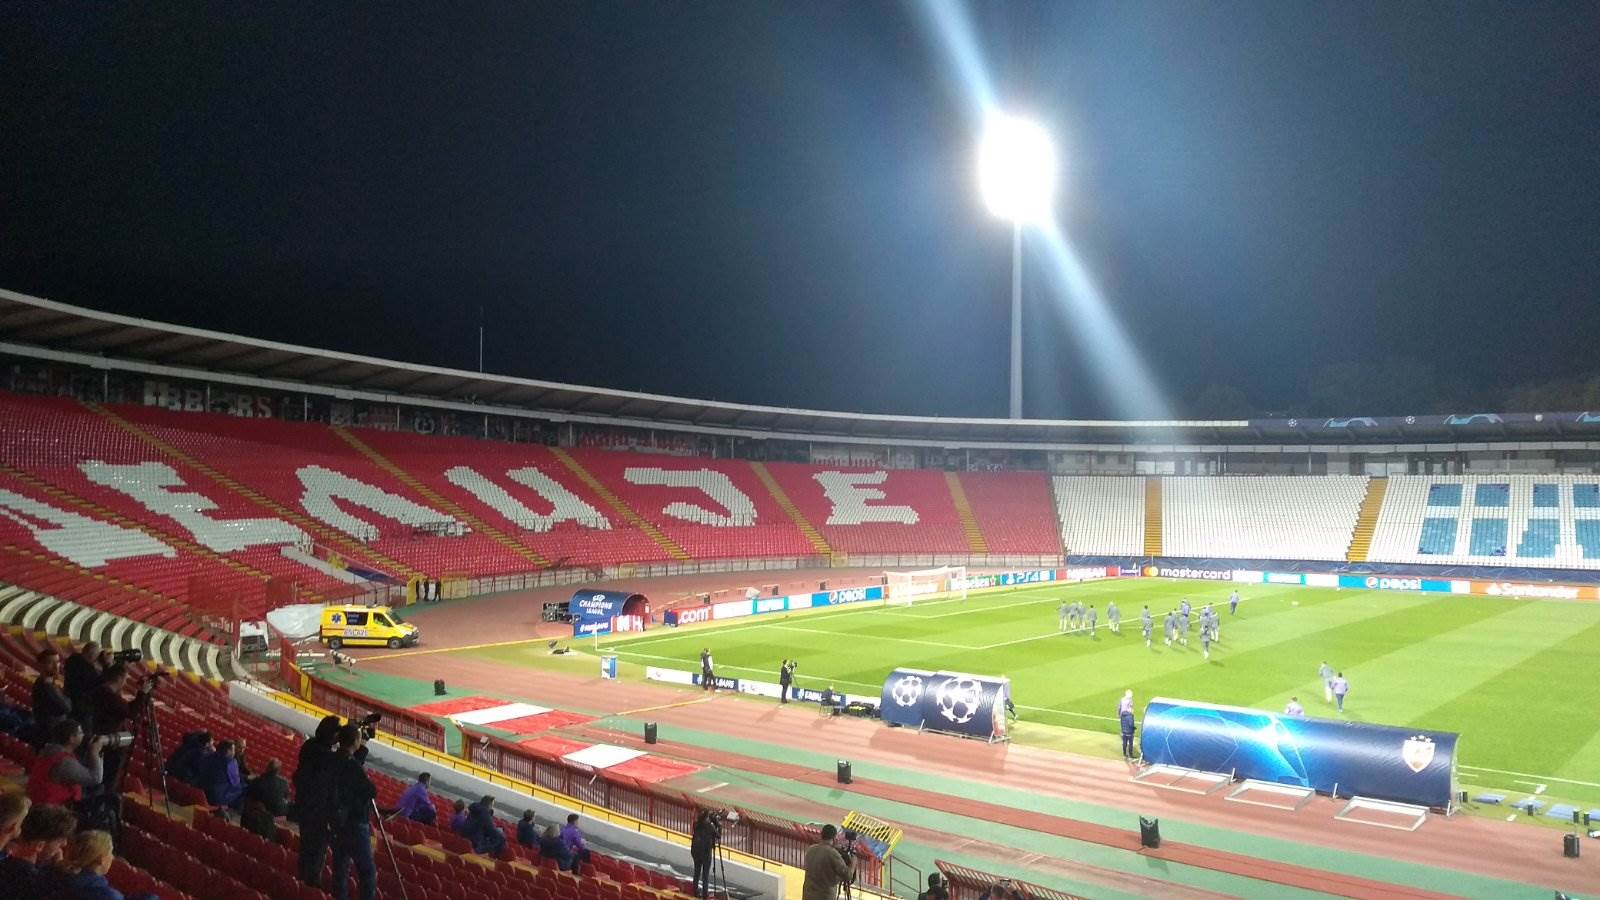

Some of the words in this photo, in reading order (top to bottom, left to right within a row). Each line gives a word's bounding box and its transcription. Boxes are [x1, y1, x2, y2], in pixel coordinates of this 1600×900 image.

[1160, 567, 1231, 580] mastercard
[1379, 577, 1422, 591] pepsi
[838, 588, 865, 603] pepsi
[578, 599, 613, 610] CHAMPIONS
[678, 609, 709, 624] .com
